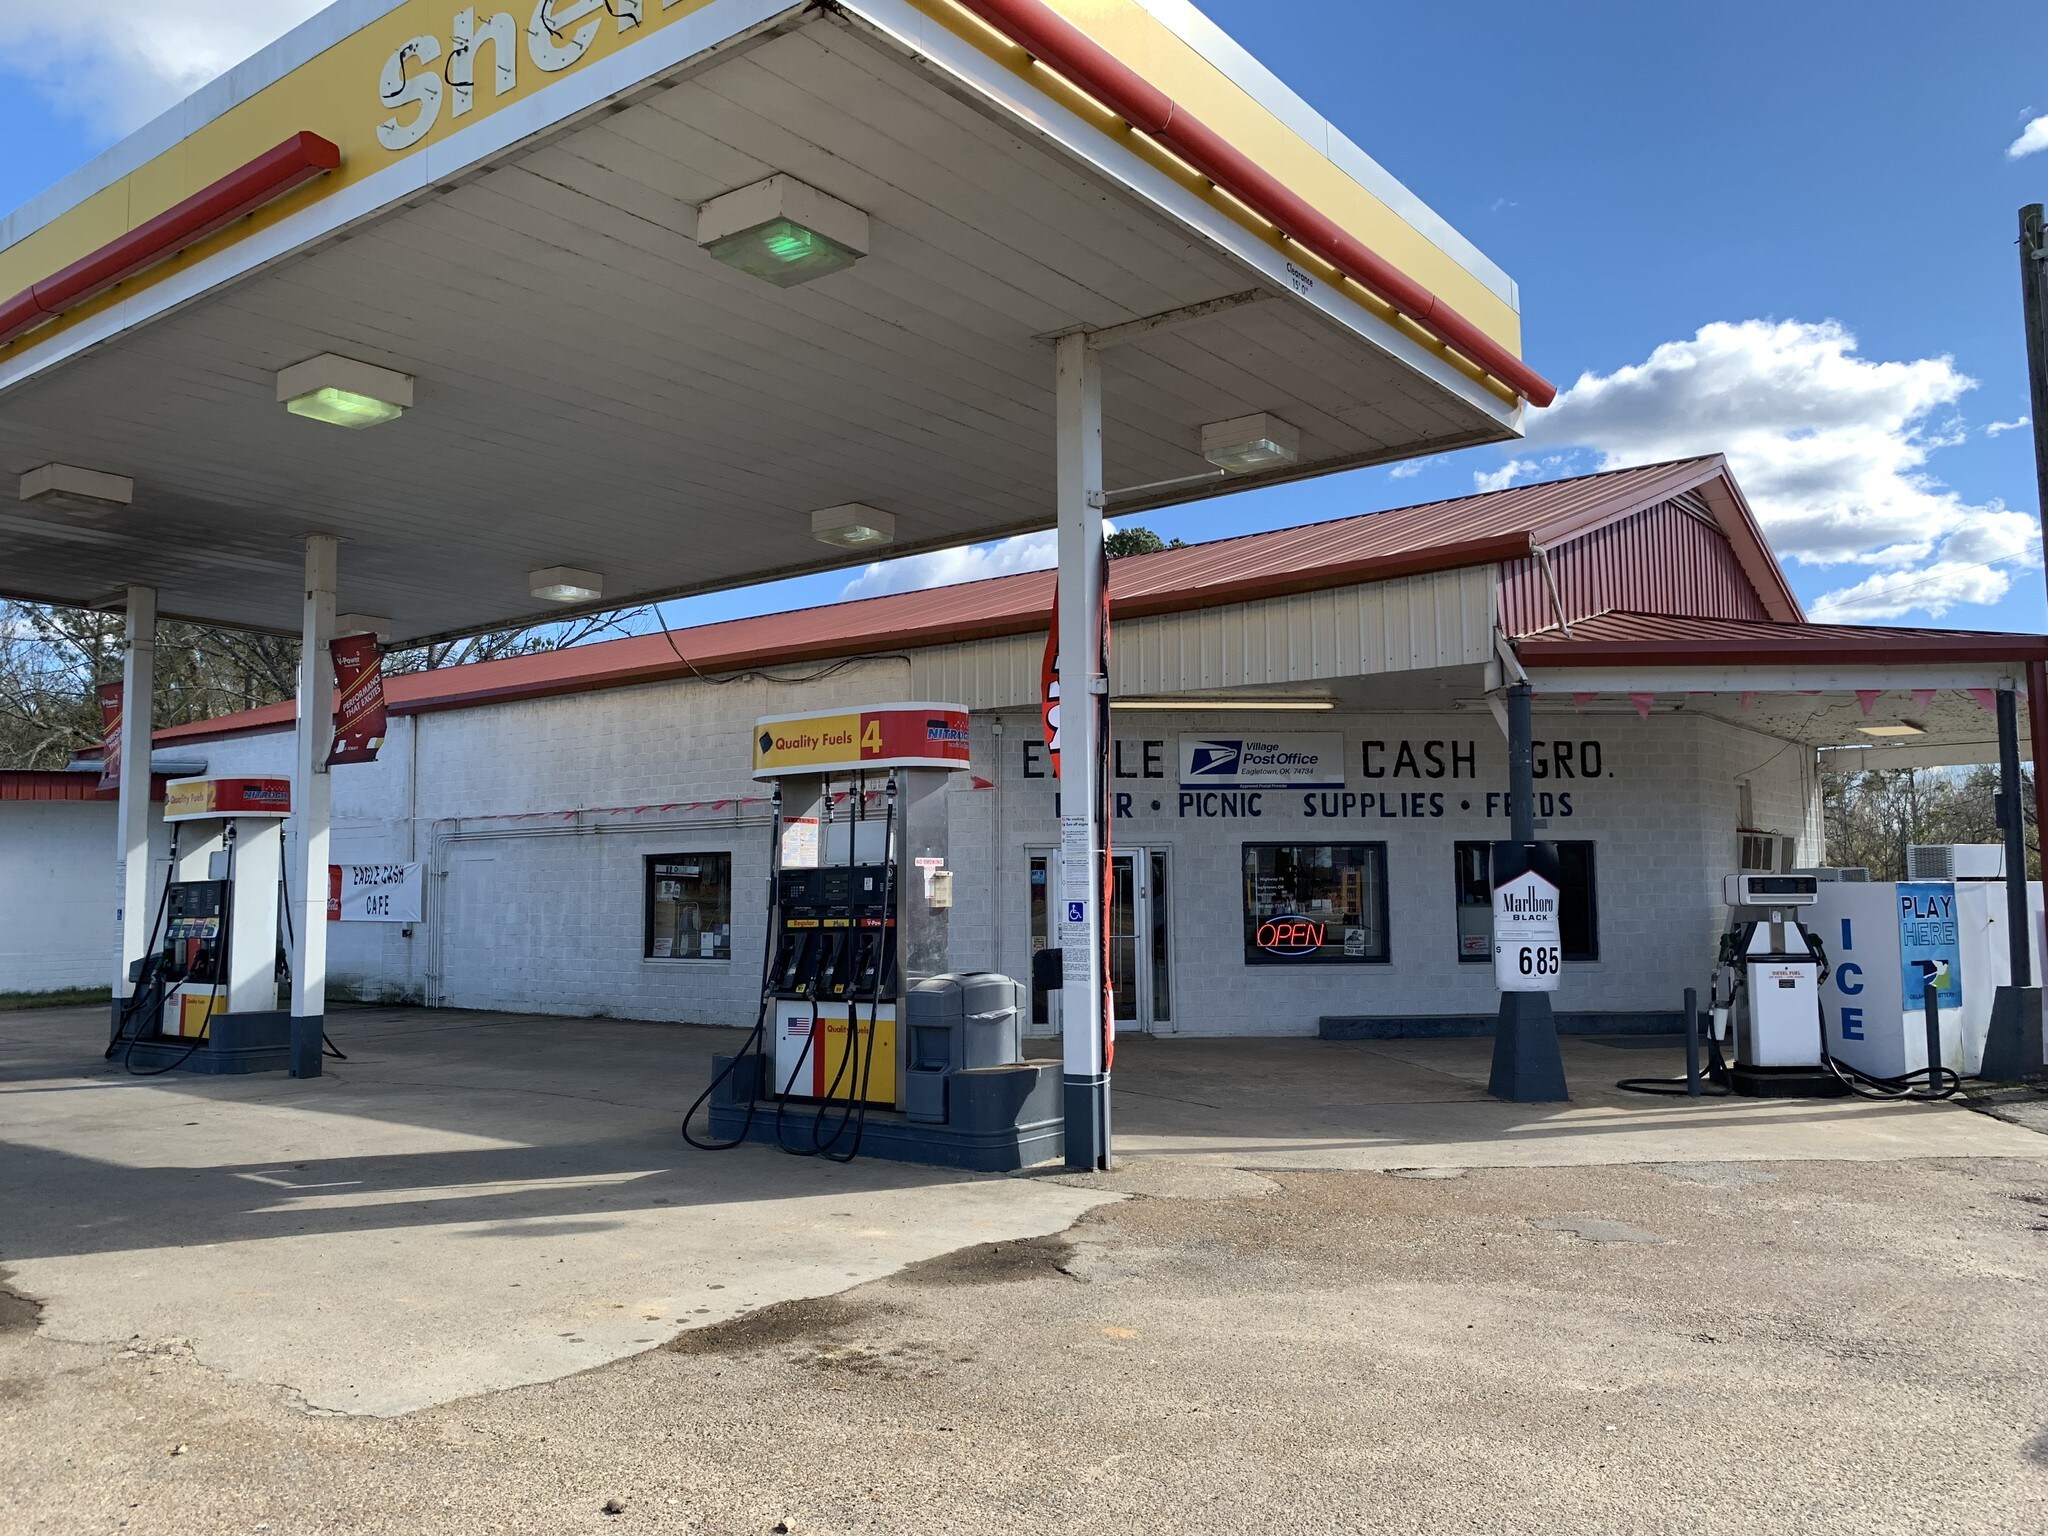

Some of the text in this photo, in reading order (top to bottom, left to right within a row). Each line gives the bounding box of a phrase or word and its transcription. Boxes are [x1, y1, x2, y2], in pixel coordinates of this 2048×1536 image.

[376, 0, 684, 151] She
[1286, 262, 1314, 287] Clearance
[342, 673, 381, 712] PERFORMANCE
[345, 684, 381, 718] THAT EXCITES
[775, 720, 969, 753] Quality Fuels 4 NITROG
[1246, 742, 1279, 753] Village
[1023, 740, 1614, 778] ELE CASH GRO.
[1243, 753, 1319, 765] Post Office
[1241, 768, 1279, 776] Eagletown,
[1179, 792, 1573, 818] PICNIC SUPPLIES FEDS
[352, 865, 404, 885] EAGLE CASH
[366, 895, 389, 915] CAFE
[1503, 886, 1554, 912] Marlboro
[1901, 896, 1953, 919] PLAY
[793, 919, 815, 927] Regular
[1257, 923, 1324, 947] OPEN
[1903, 921, 1955, 946] HERE
[1496, 945, 1502, 953] $
[1835, 918, 1865, 1041] ICE
[857, 1026, 869, 1034] uels
